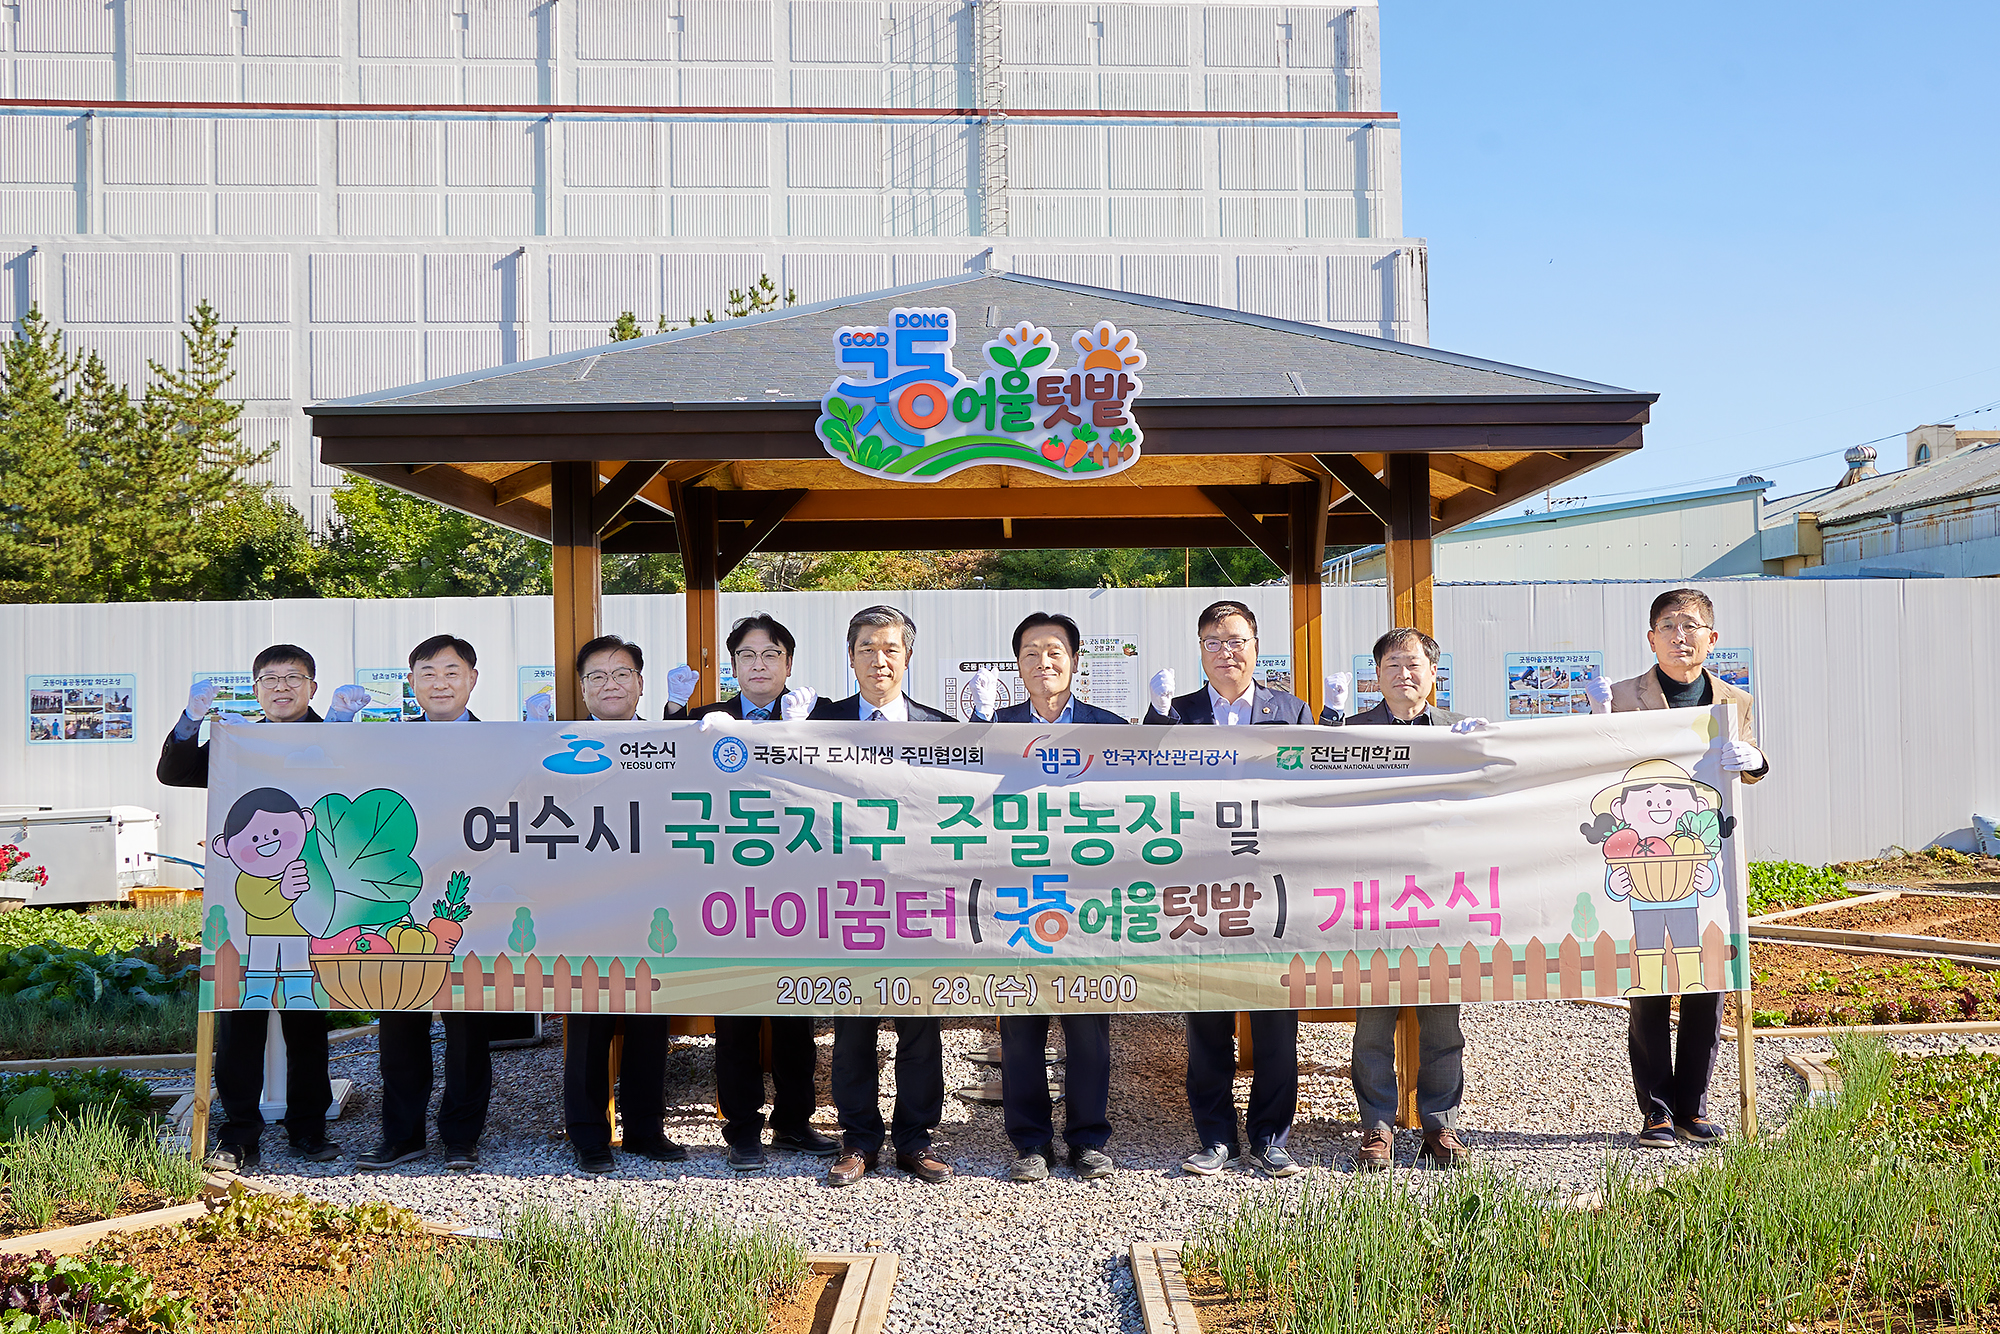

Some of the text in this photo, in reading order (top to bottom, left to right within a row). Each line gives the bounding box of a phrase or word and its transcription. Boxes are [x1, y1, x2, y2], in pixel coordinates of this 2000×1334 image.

[839, 313, 949, 347] GOOD DONG
[1566, 655, 1590, 663] 자갈조성
[619, 741, 676, 759] 여수시
[753, 745, 984, 766] 국동지구 도시재생 주민협의회
[1102, 748, 1239, 766] 한국자산관리공사
[1310, 746, 1411, 763] 전남대학교
[620, 761, 676, 770] YEOSU CITY
[1035, 748, 1081, 775] 캠코
[463, 790, 1262, 868] 여수시 국동지구 주말농장 및
[1312, 866, 1502, 937] 개소식
[777, 974, 1138, 1007] 2026. 10. 28.(수) 14:00
